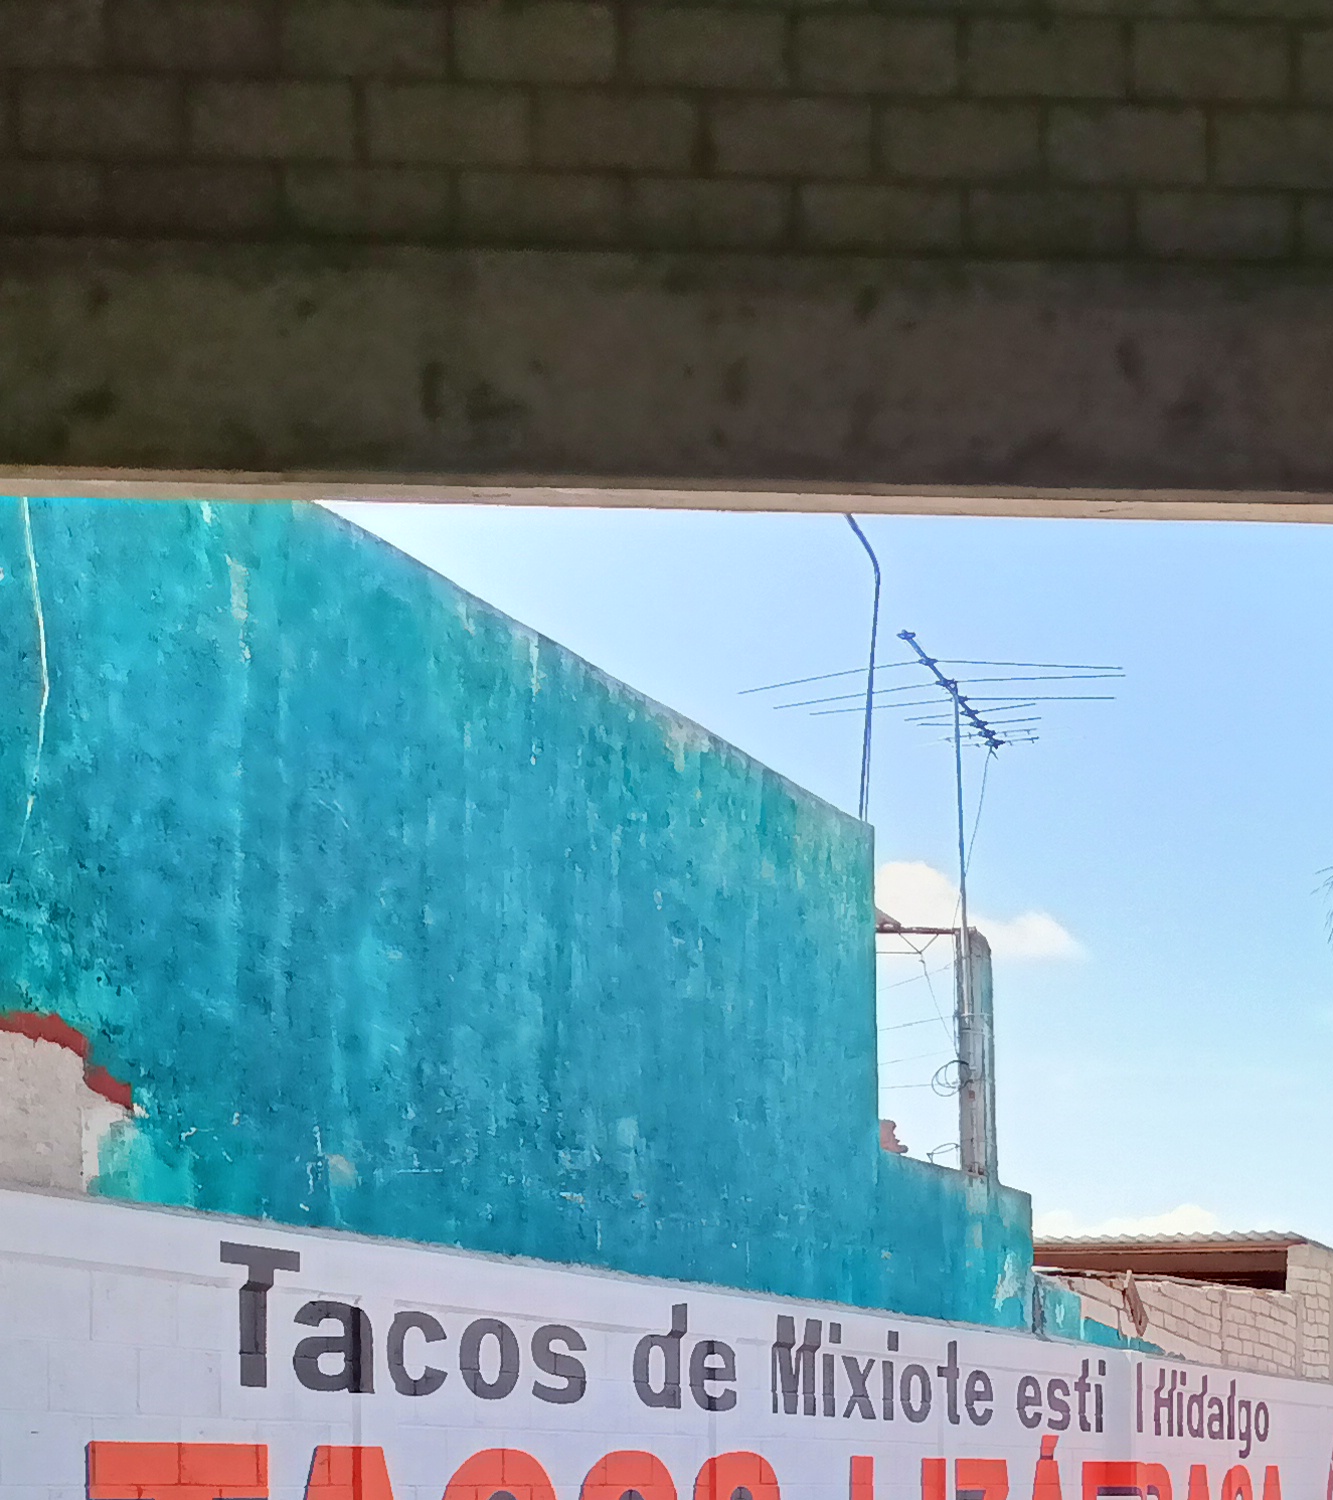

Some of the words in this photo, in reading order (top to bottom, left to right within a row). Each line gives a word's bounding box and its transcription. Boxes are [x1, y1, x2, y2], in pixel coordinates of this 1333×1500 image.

[220, 1240, 588, 1405] Tacos
[633, 1303, 738, 1412] de
[771, 1315, 994, 1427] Mixiote
[1153, 1367, 1270, 1460] Hidalgo
